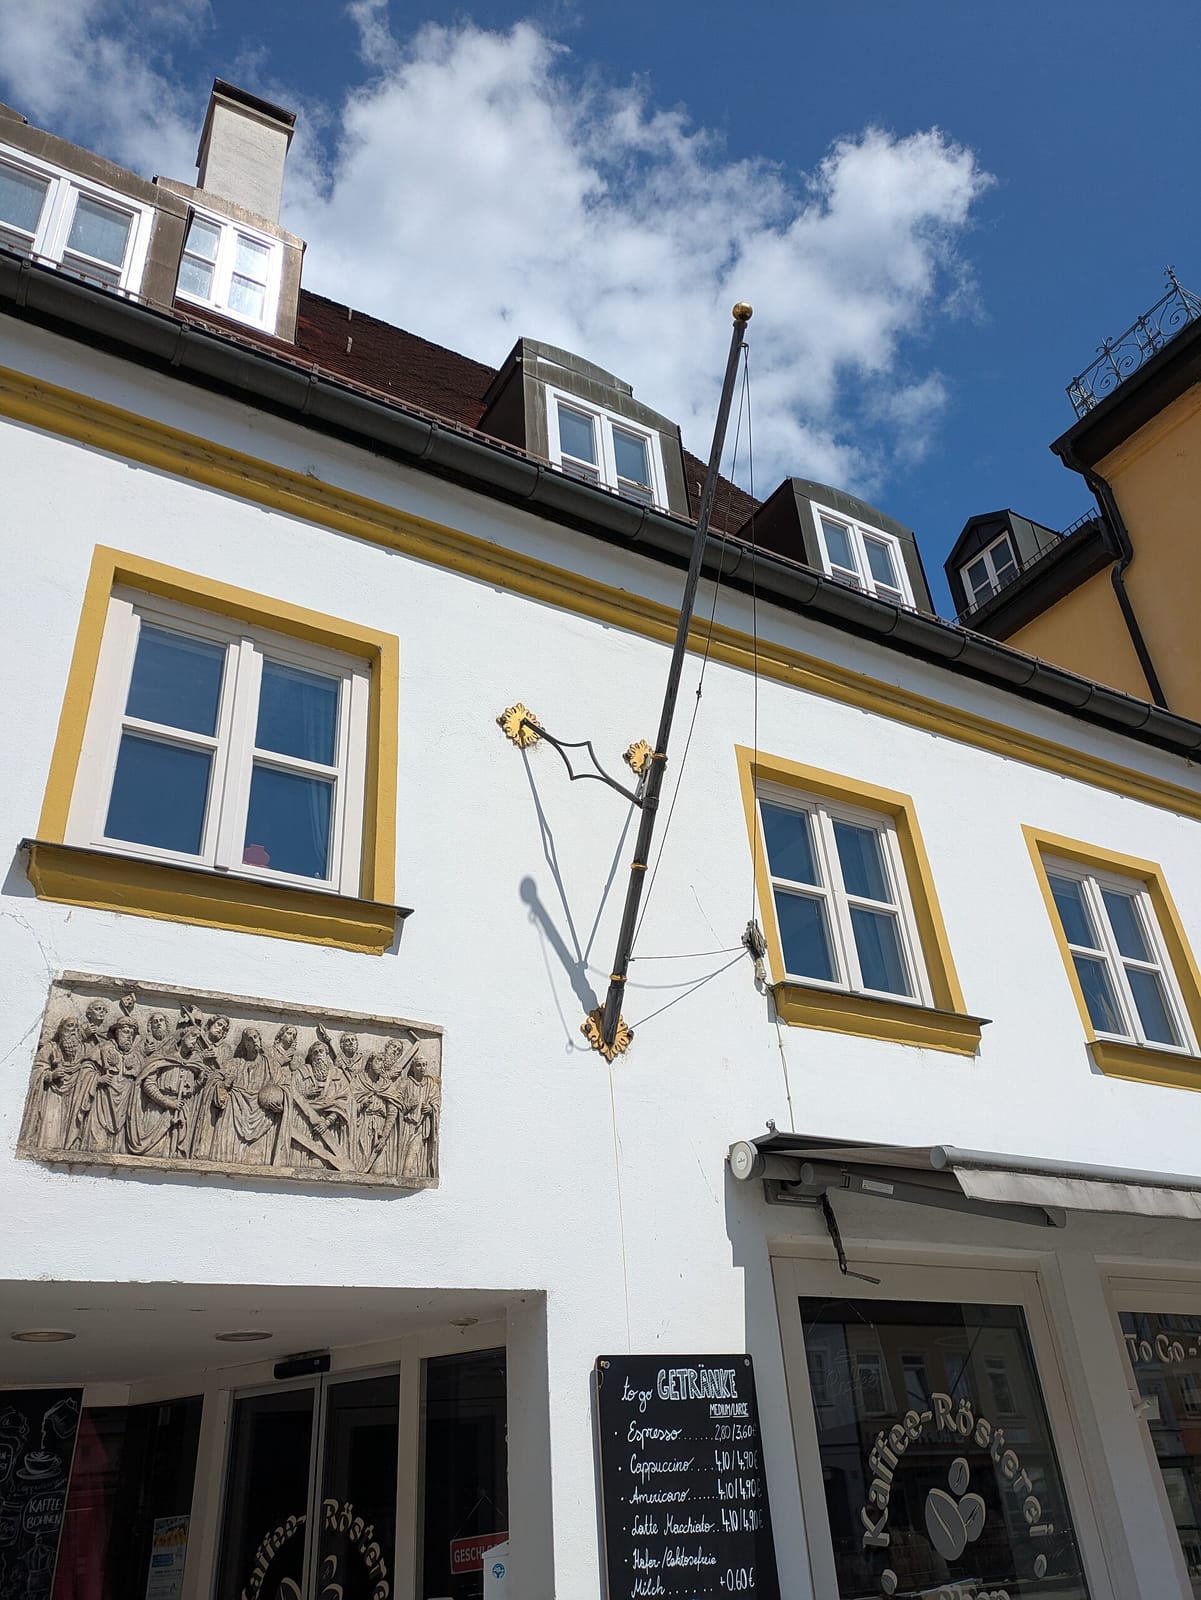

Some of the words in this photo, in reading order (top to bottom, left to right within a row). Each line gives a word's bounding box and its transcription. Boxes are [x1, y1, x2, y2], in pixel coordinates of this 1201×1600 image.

[656, 1363, 738, 1401] GETRÄNKE
[627, 1420, 683, 1450] Espresso
[630, 1453, 695, 1485] Cappuccino
[861, 1392, 1054, 1548] Kaffee-Rösterei
[629, 1485, 691, 1505] Americano
[631, 1513, 659, 1536] Latte
[663, 1511, 716, 1536] Macchiato
[631, 1575, 666, 1598] Milch
